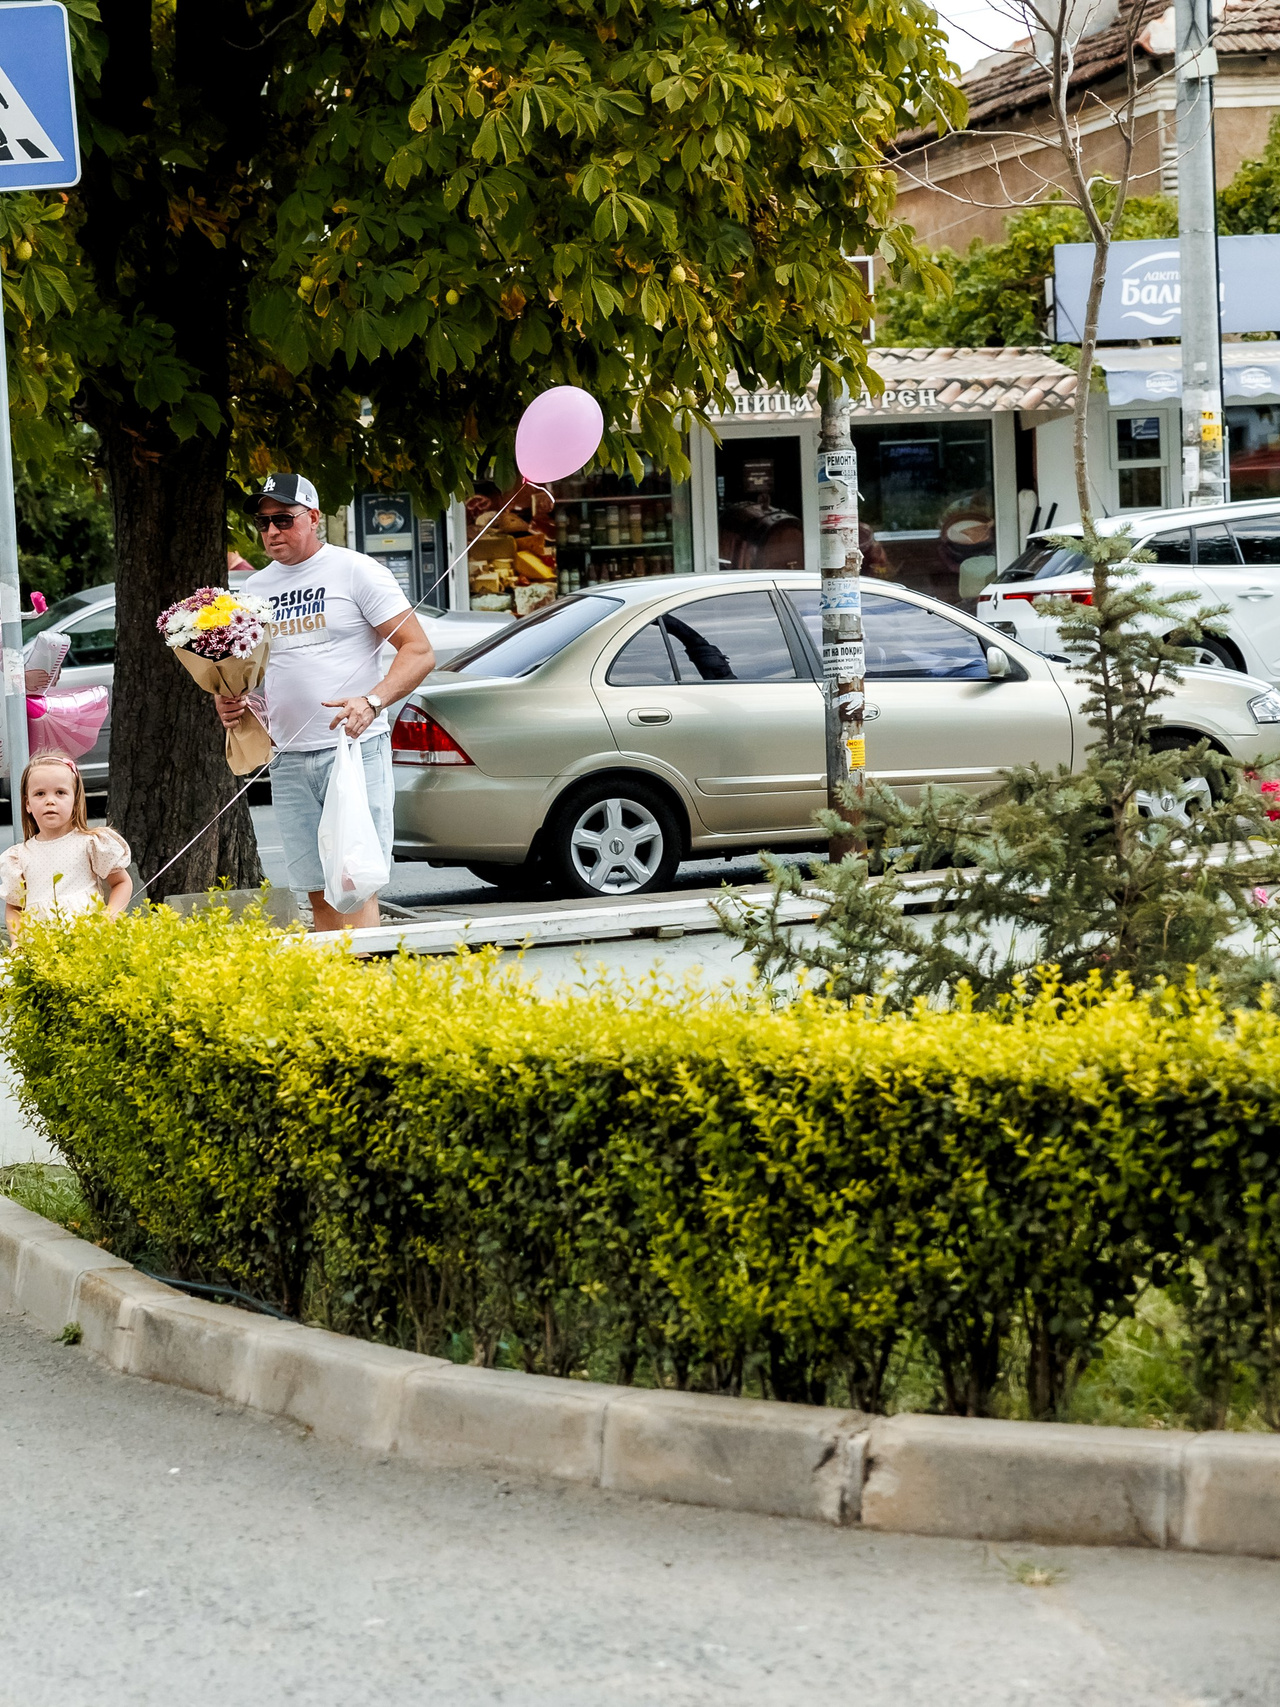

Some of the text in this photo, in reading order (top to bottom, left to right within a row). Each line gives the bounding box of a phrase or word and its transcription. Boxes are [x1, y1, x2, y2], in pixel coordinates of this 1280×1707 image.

[263, 476, 276, 493] LA
[269, 586, 326, 610] DESIGN
[270, 613, 326, 638] DESIGN
